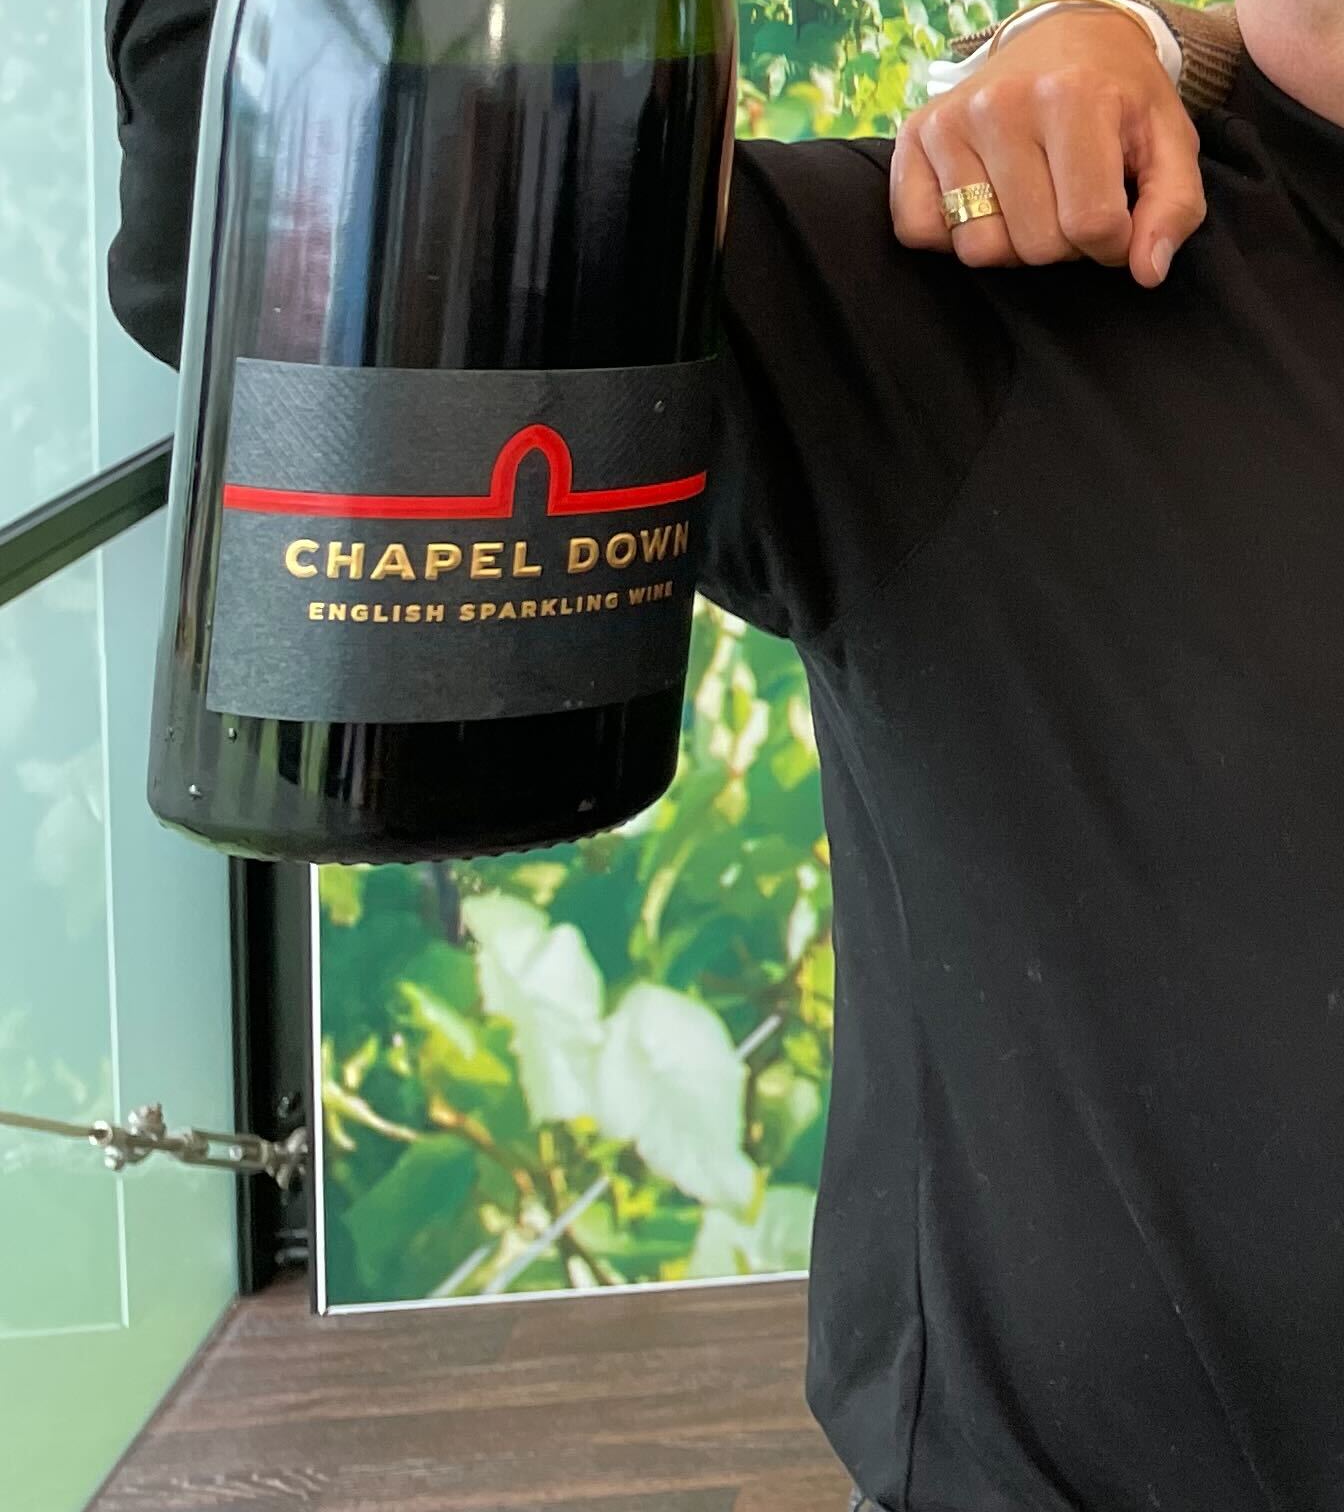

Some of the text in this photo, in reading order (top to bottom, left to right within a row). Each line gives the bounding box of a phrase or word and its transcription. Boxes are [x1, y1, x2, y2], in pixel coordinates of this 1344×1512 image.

[284, 520, 690, 581] CHAPEL DOWN
[308, 580, 674, 623] ENGLISH SPARKLING WINE
